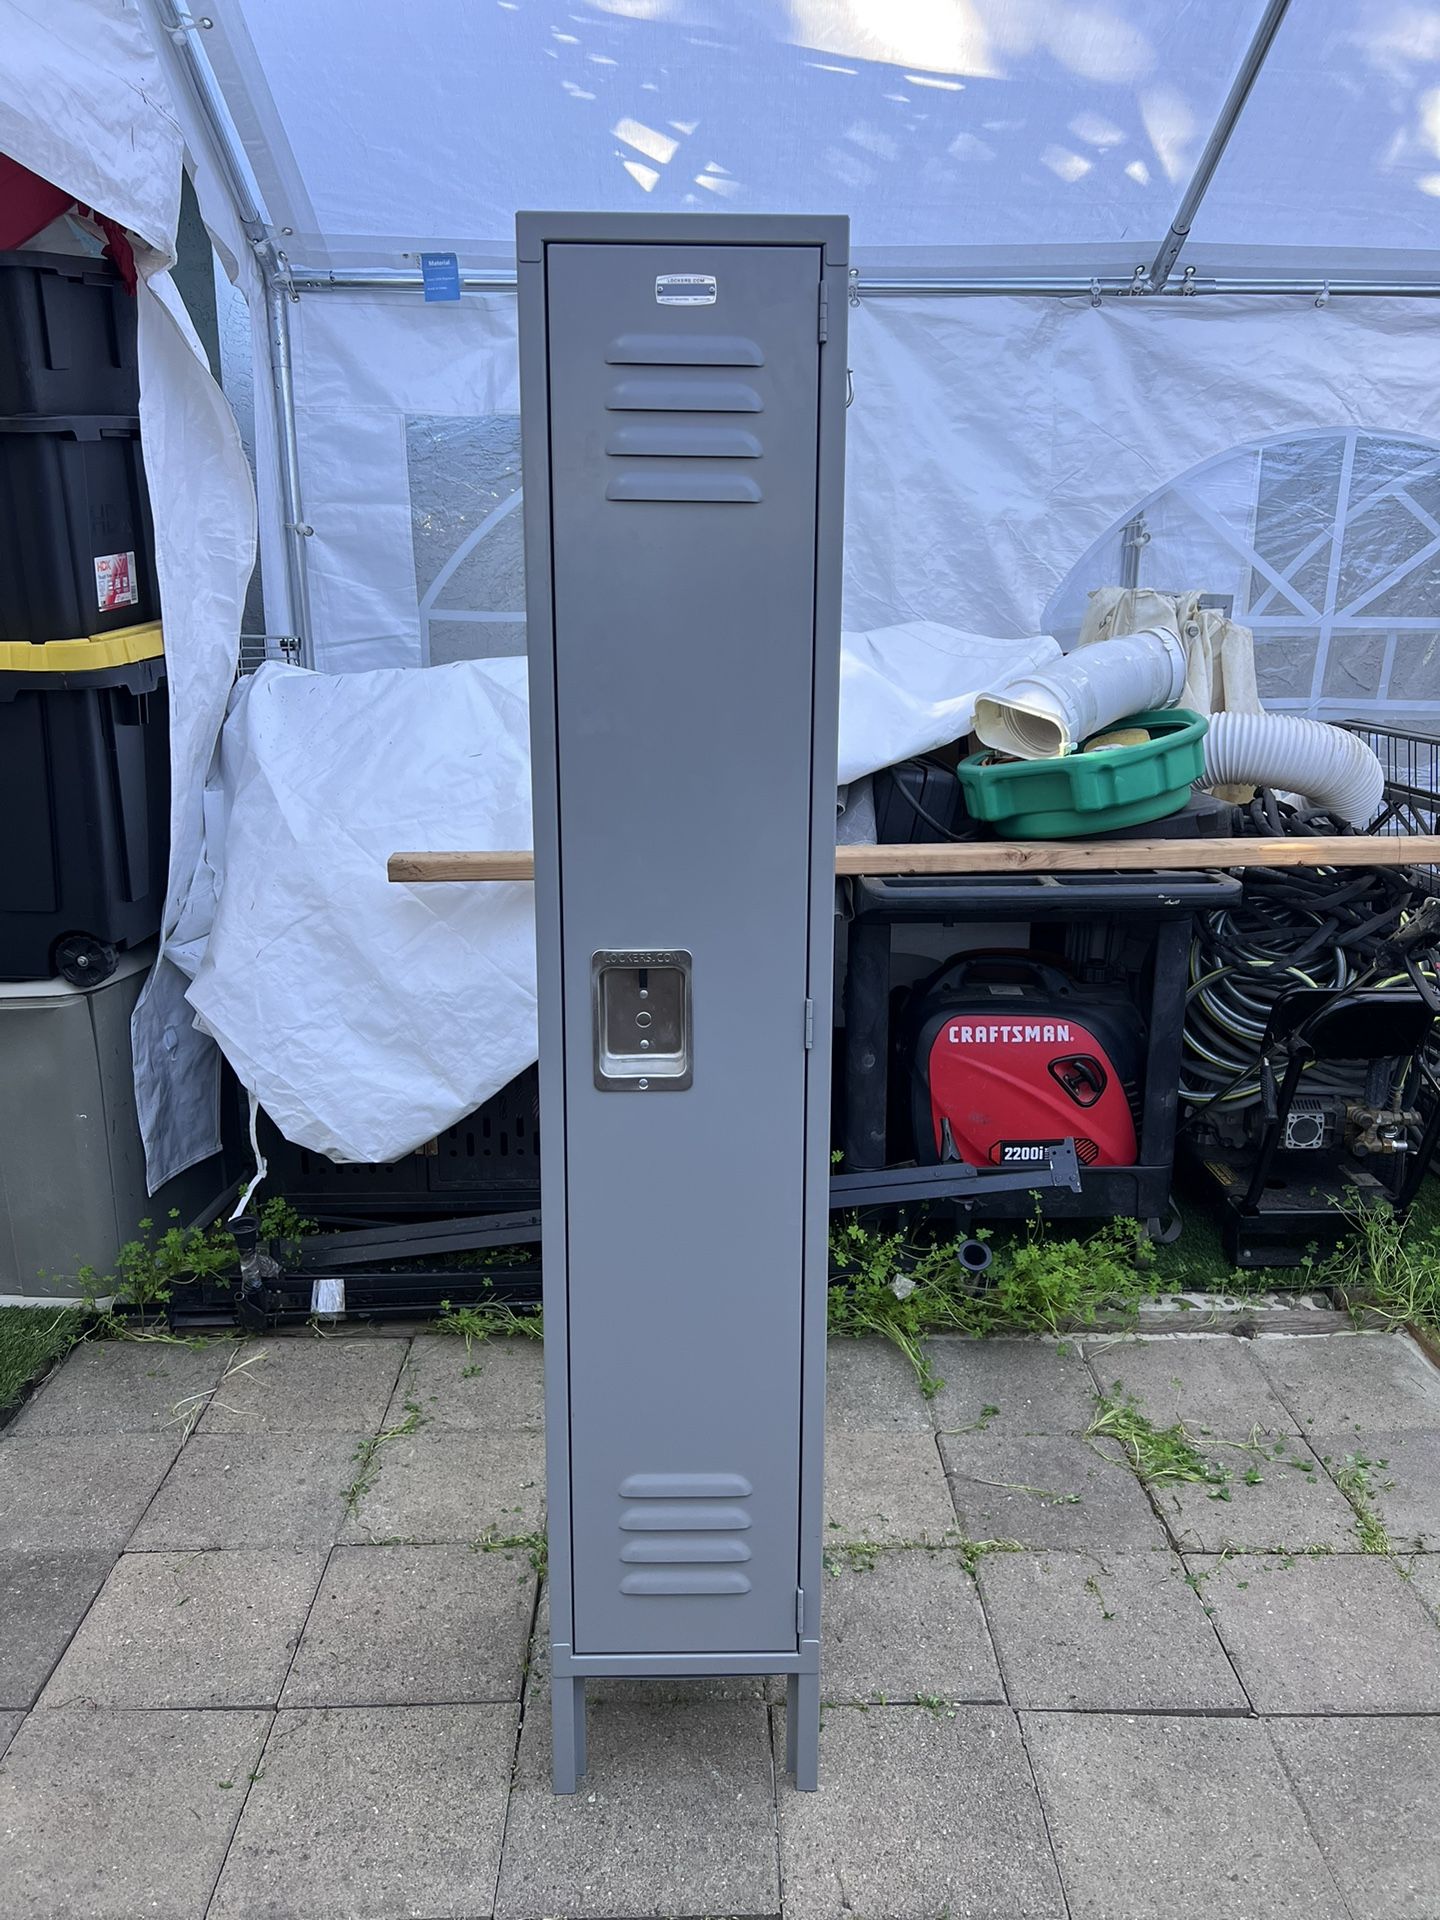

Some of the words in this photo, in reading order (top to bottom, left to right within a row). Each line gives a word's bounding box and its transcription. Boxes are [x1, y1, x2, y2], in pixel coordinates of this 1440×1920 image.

[604, 952, 681, 963] LOCKERS.COM
[949, 1025, 1070, 1043] CRAFTSMAN
[1004, 1146, 1043, 1160] 2200i
